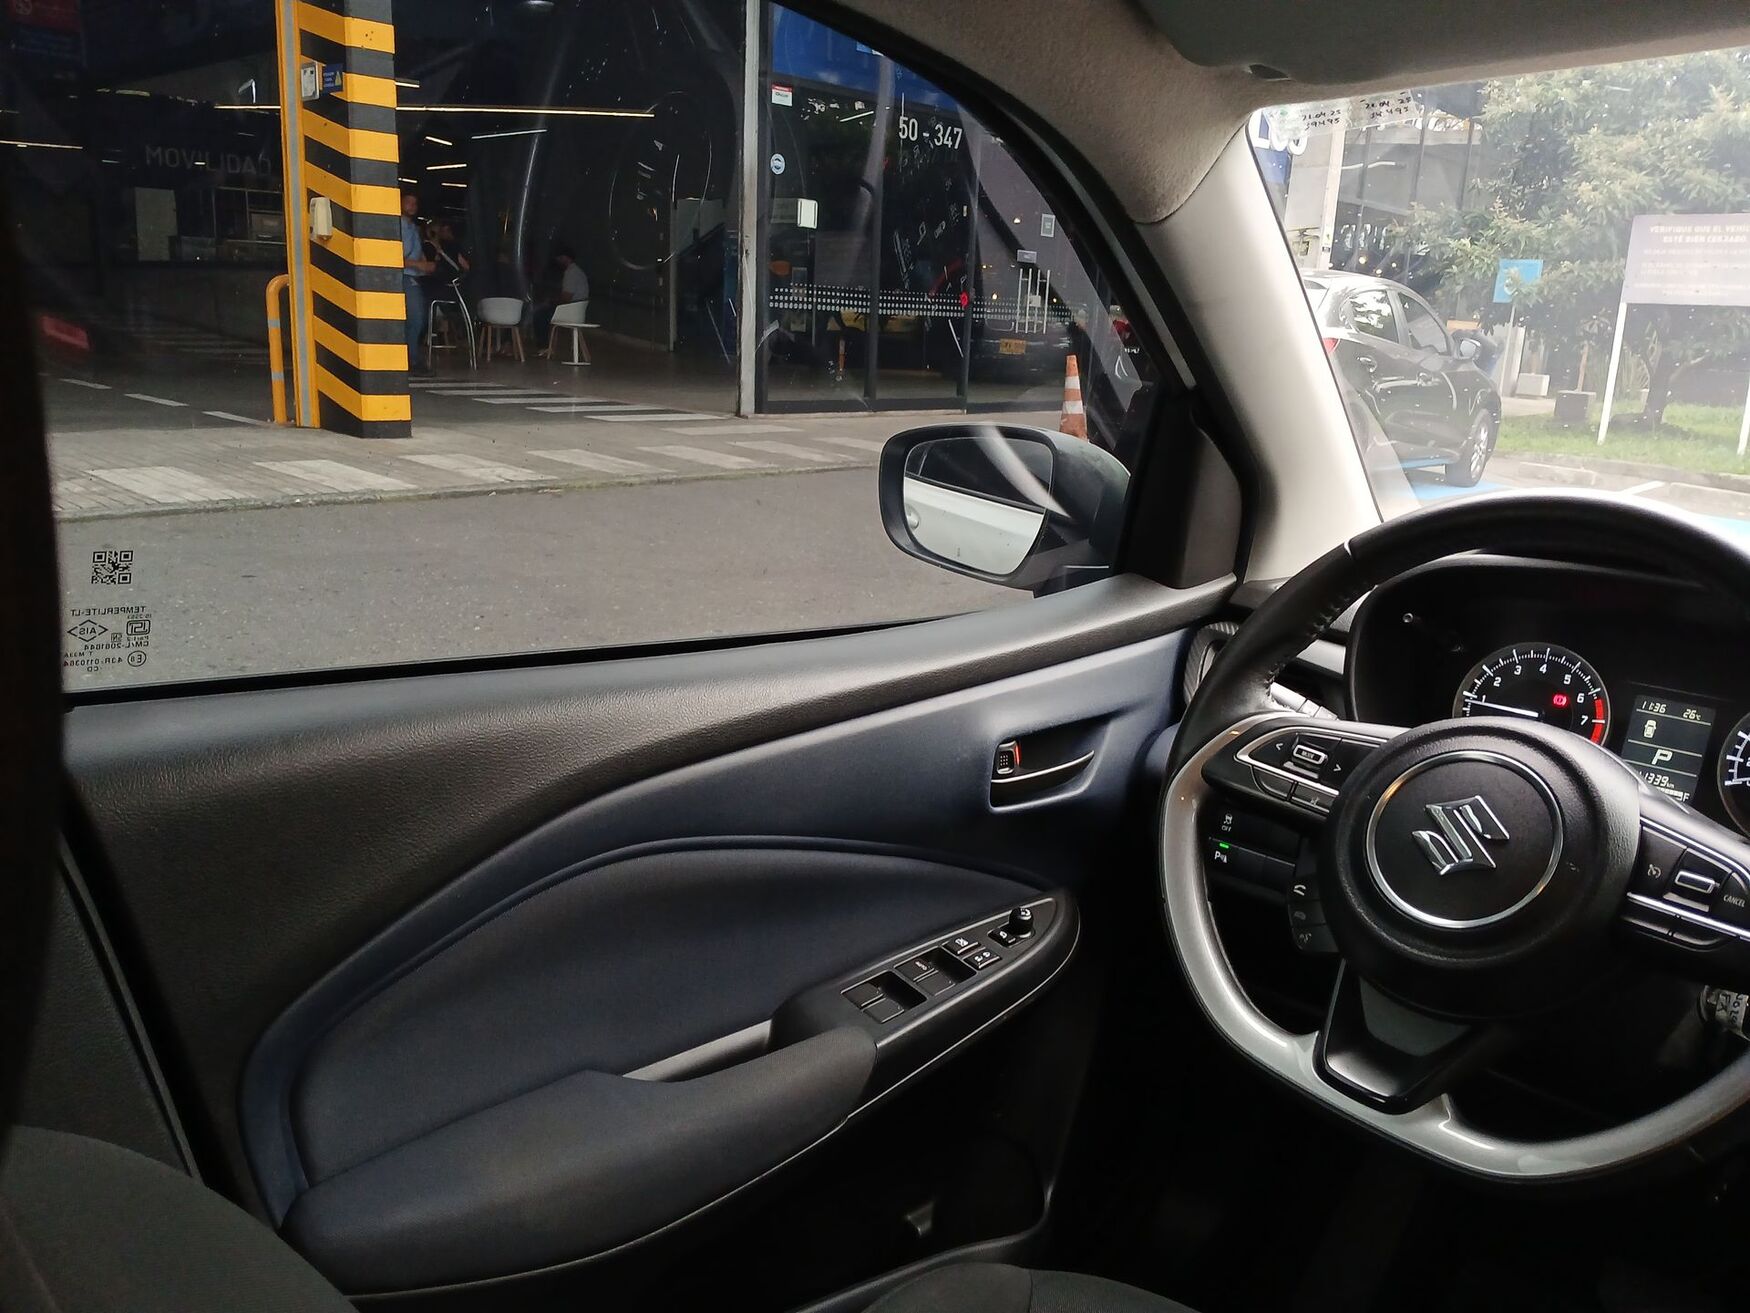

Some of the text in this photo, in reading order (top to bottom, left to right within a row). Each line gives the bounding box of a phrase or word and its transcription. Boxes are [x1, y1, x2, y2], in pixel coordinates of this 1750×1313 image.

[898, 116, 918, 141] 50
[934, 124, 963, 150] 347
[145, 144, 271, 176] MOVILIDAD
[1513, 665, 1522, 676] 3
[1539, 663, 1548, 674] 4
[1493, 676, 1502, 687] 2
[1563, 674, 1572, 685] 5
[1576, 693, 1585, 703] 6
[1642, 701, 1667, 714] 11:36
[1580, 715, 1589, 726] 7
[1651, 748, 1673, 765] P
[1683, 792, 1690, 802] F
[1723, 894, 1746, 908] CANCEL
